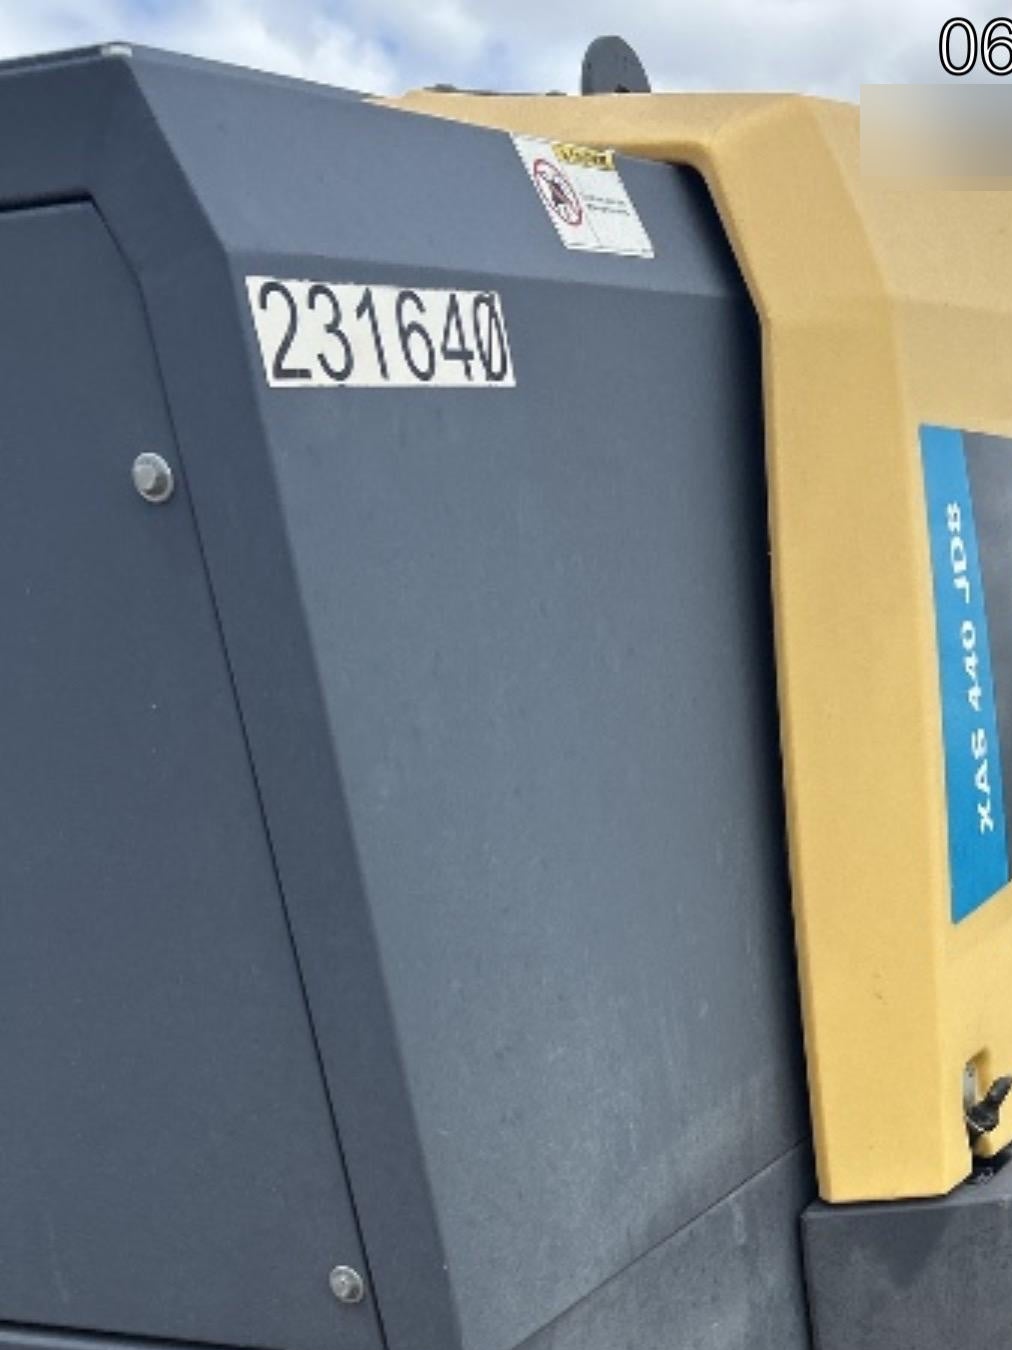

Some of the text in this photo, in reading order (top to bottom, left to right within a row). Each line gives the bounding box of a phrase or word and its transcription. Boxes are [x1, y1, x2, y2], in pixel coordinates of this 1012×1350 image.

[259, 281, 508, 381] 231640
[961, 620, 982, 712] 440
[970, 728, 994, 834] XAS
